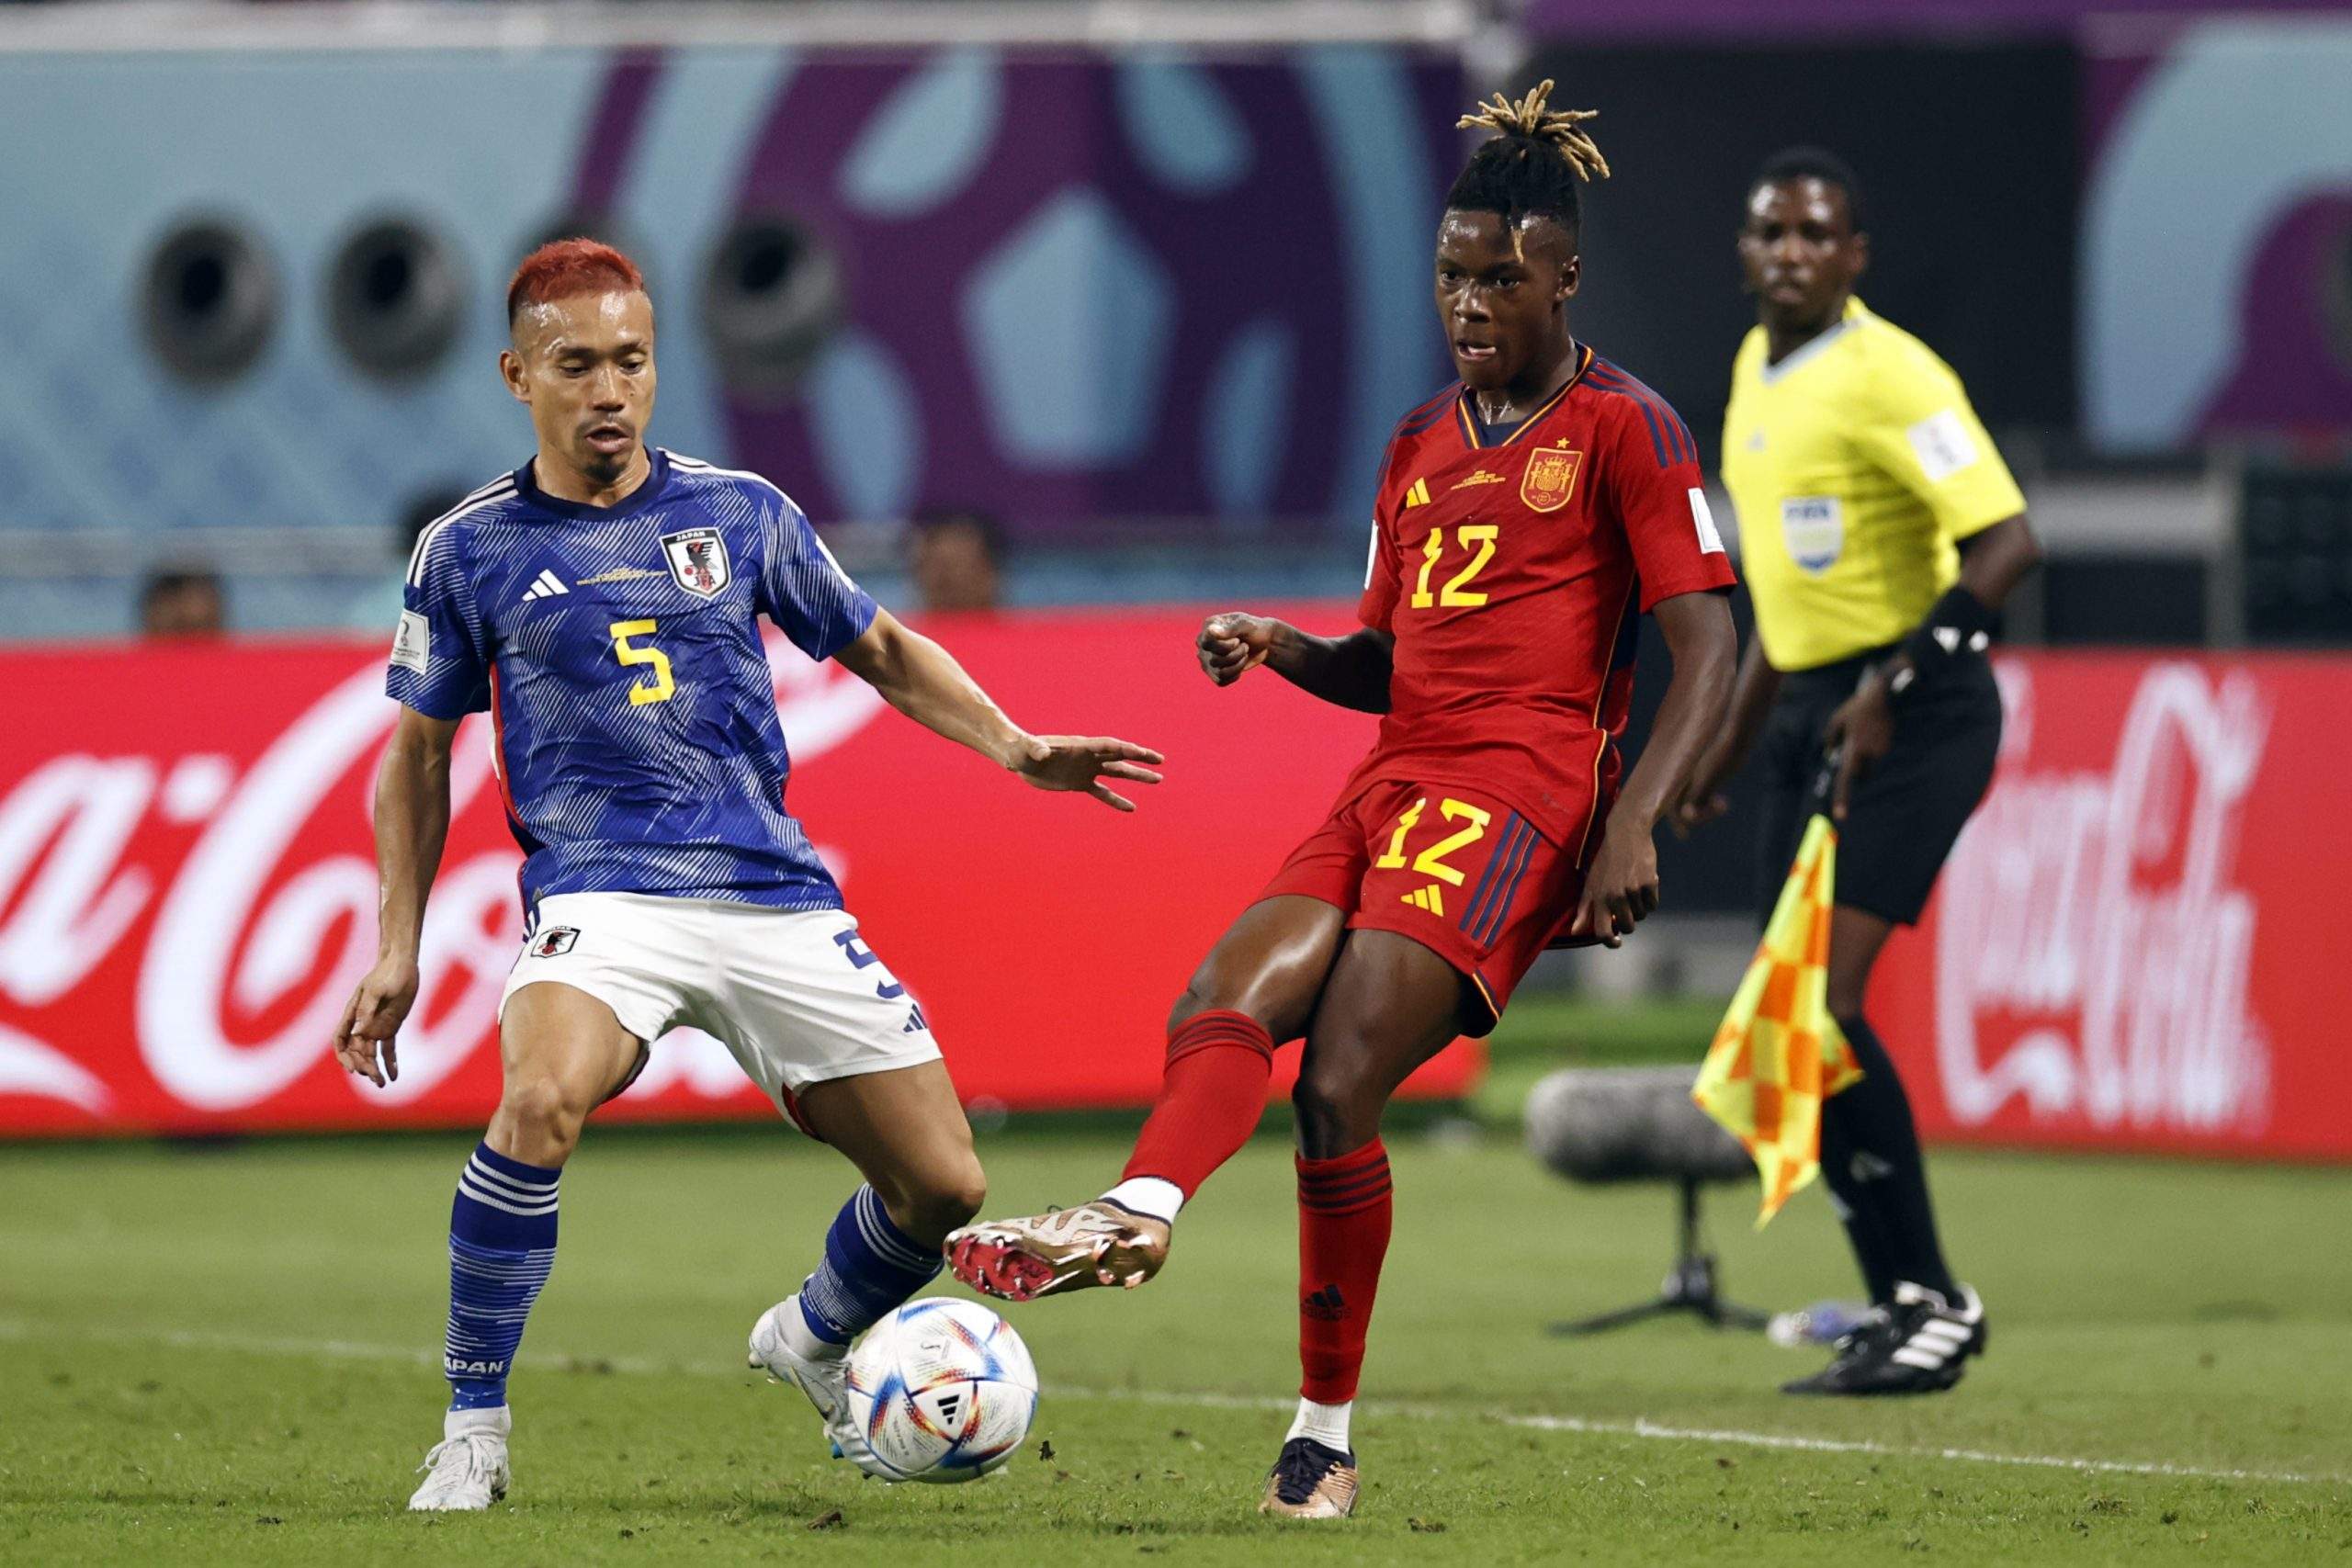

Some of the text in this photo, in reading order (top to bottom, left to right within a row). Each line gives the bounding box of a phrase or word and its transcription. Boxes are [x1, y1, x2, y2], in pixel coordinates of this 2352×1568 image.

[676, 531, 707, 542] JAPAN
[1411, 525, 1498, 609] 12
[610, 619, 676, 706] 5
[1375, 796, 1492, 887] 12
